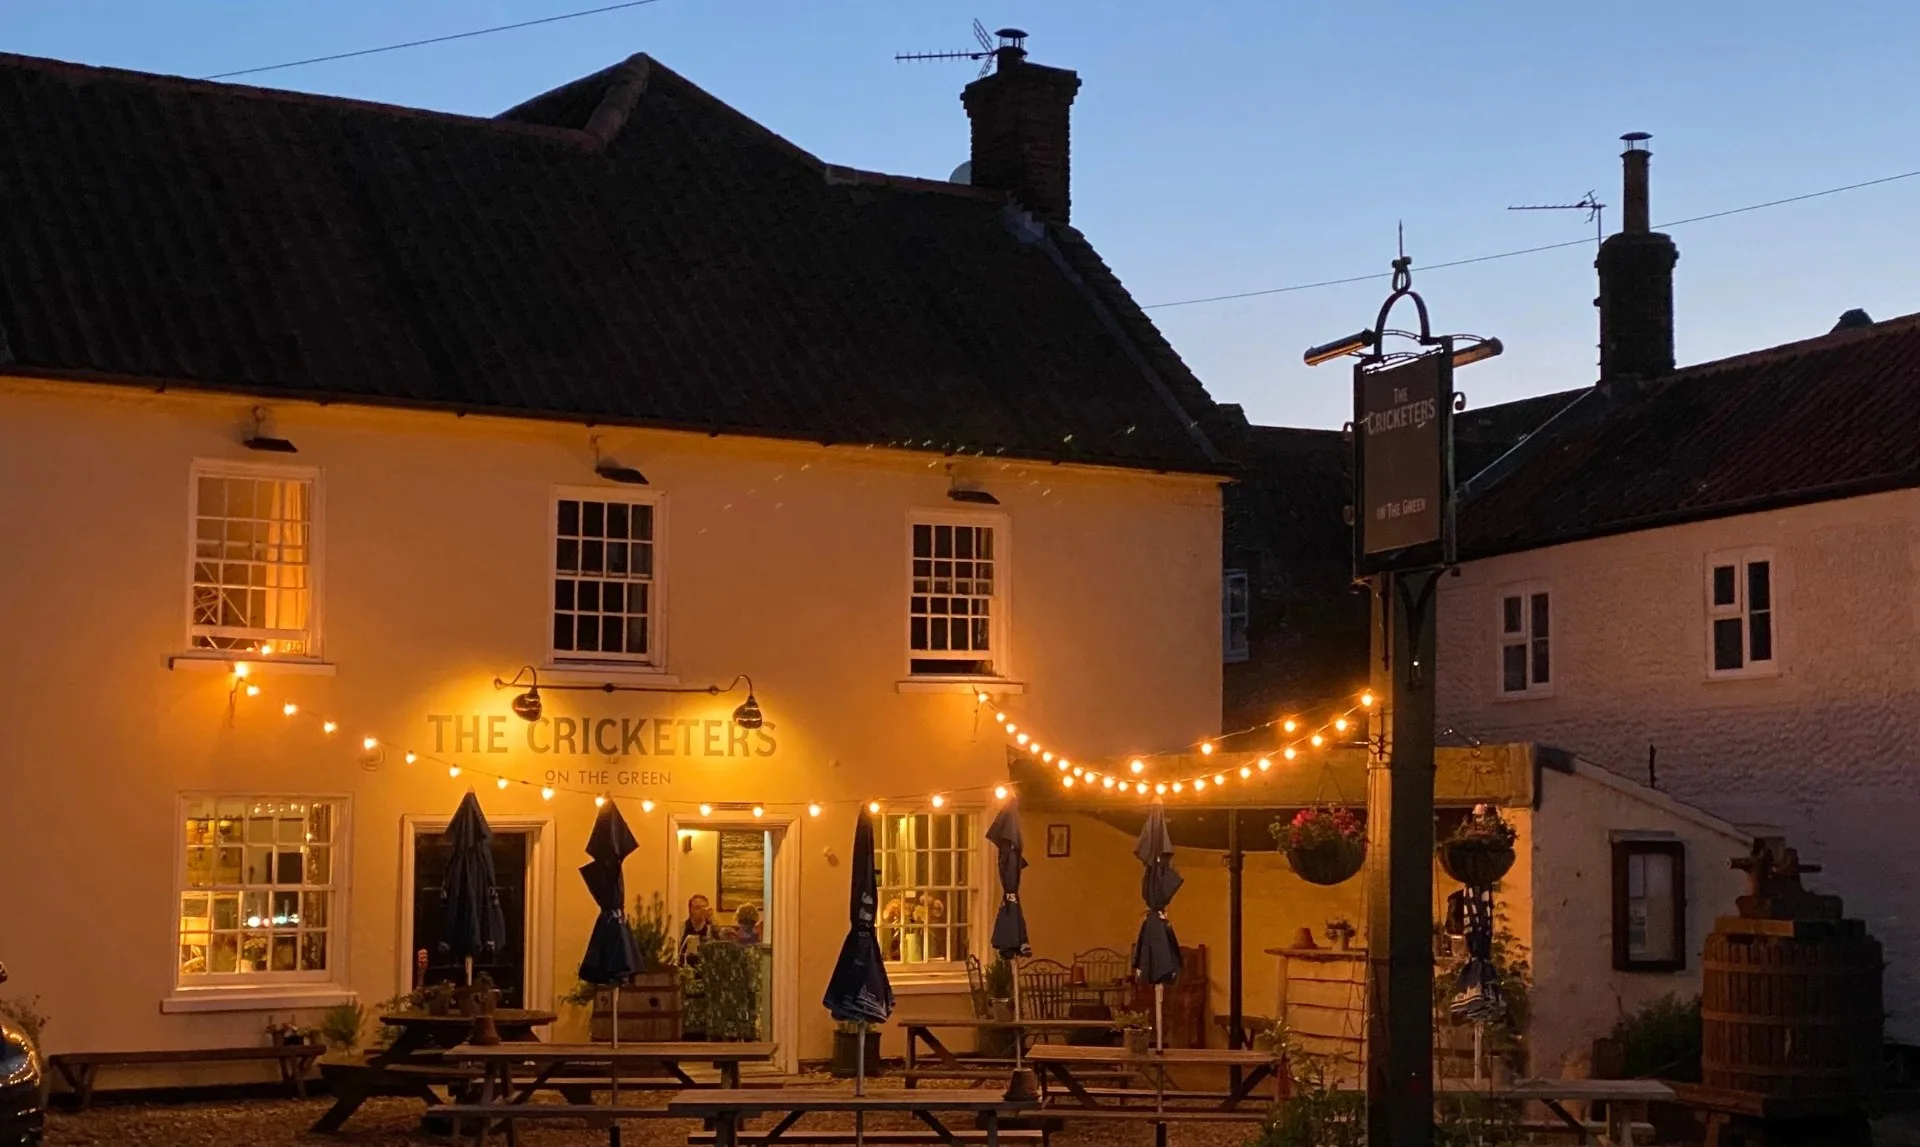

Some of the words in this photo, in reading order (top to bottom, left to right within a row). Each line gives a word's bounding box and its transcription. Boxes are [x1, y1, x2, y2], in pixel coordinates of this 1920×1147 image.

[1393, 387, 1408, 404] THE
[1367, 398, 1436, 436] CRICKETERS
[1402, 498, 1427, 515] GREEN
[427, 714, 508, 754] THE
[526, 715, 777, 757] CRICKETERS
[544, 769, 569, 785] ON
[578, 770, 609, 785] THE
[617, 770, 671, 786] GREEN
